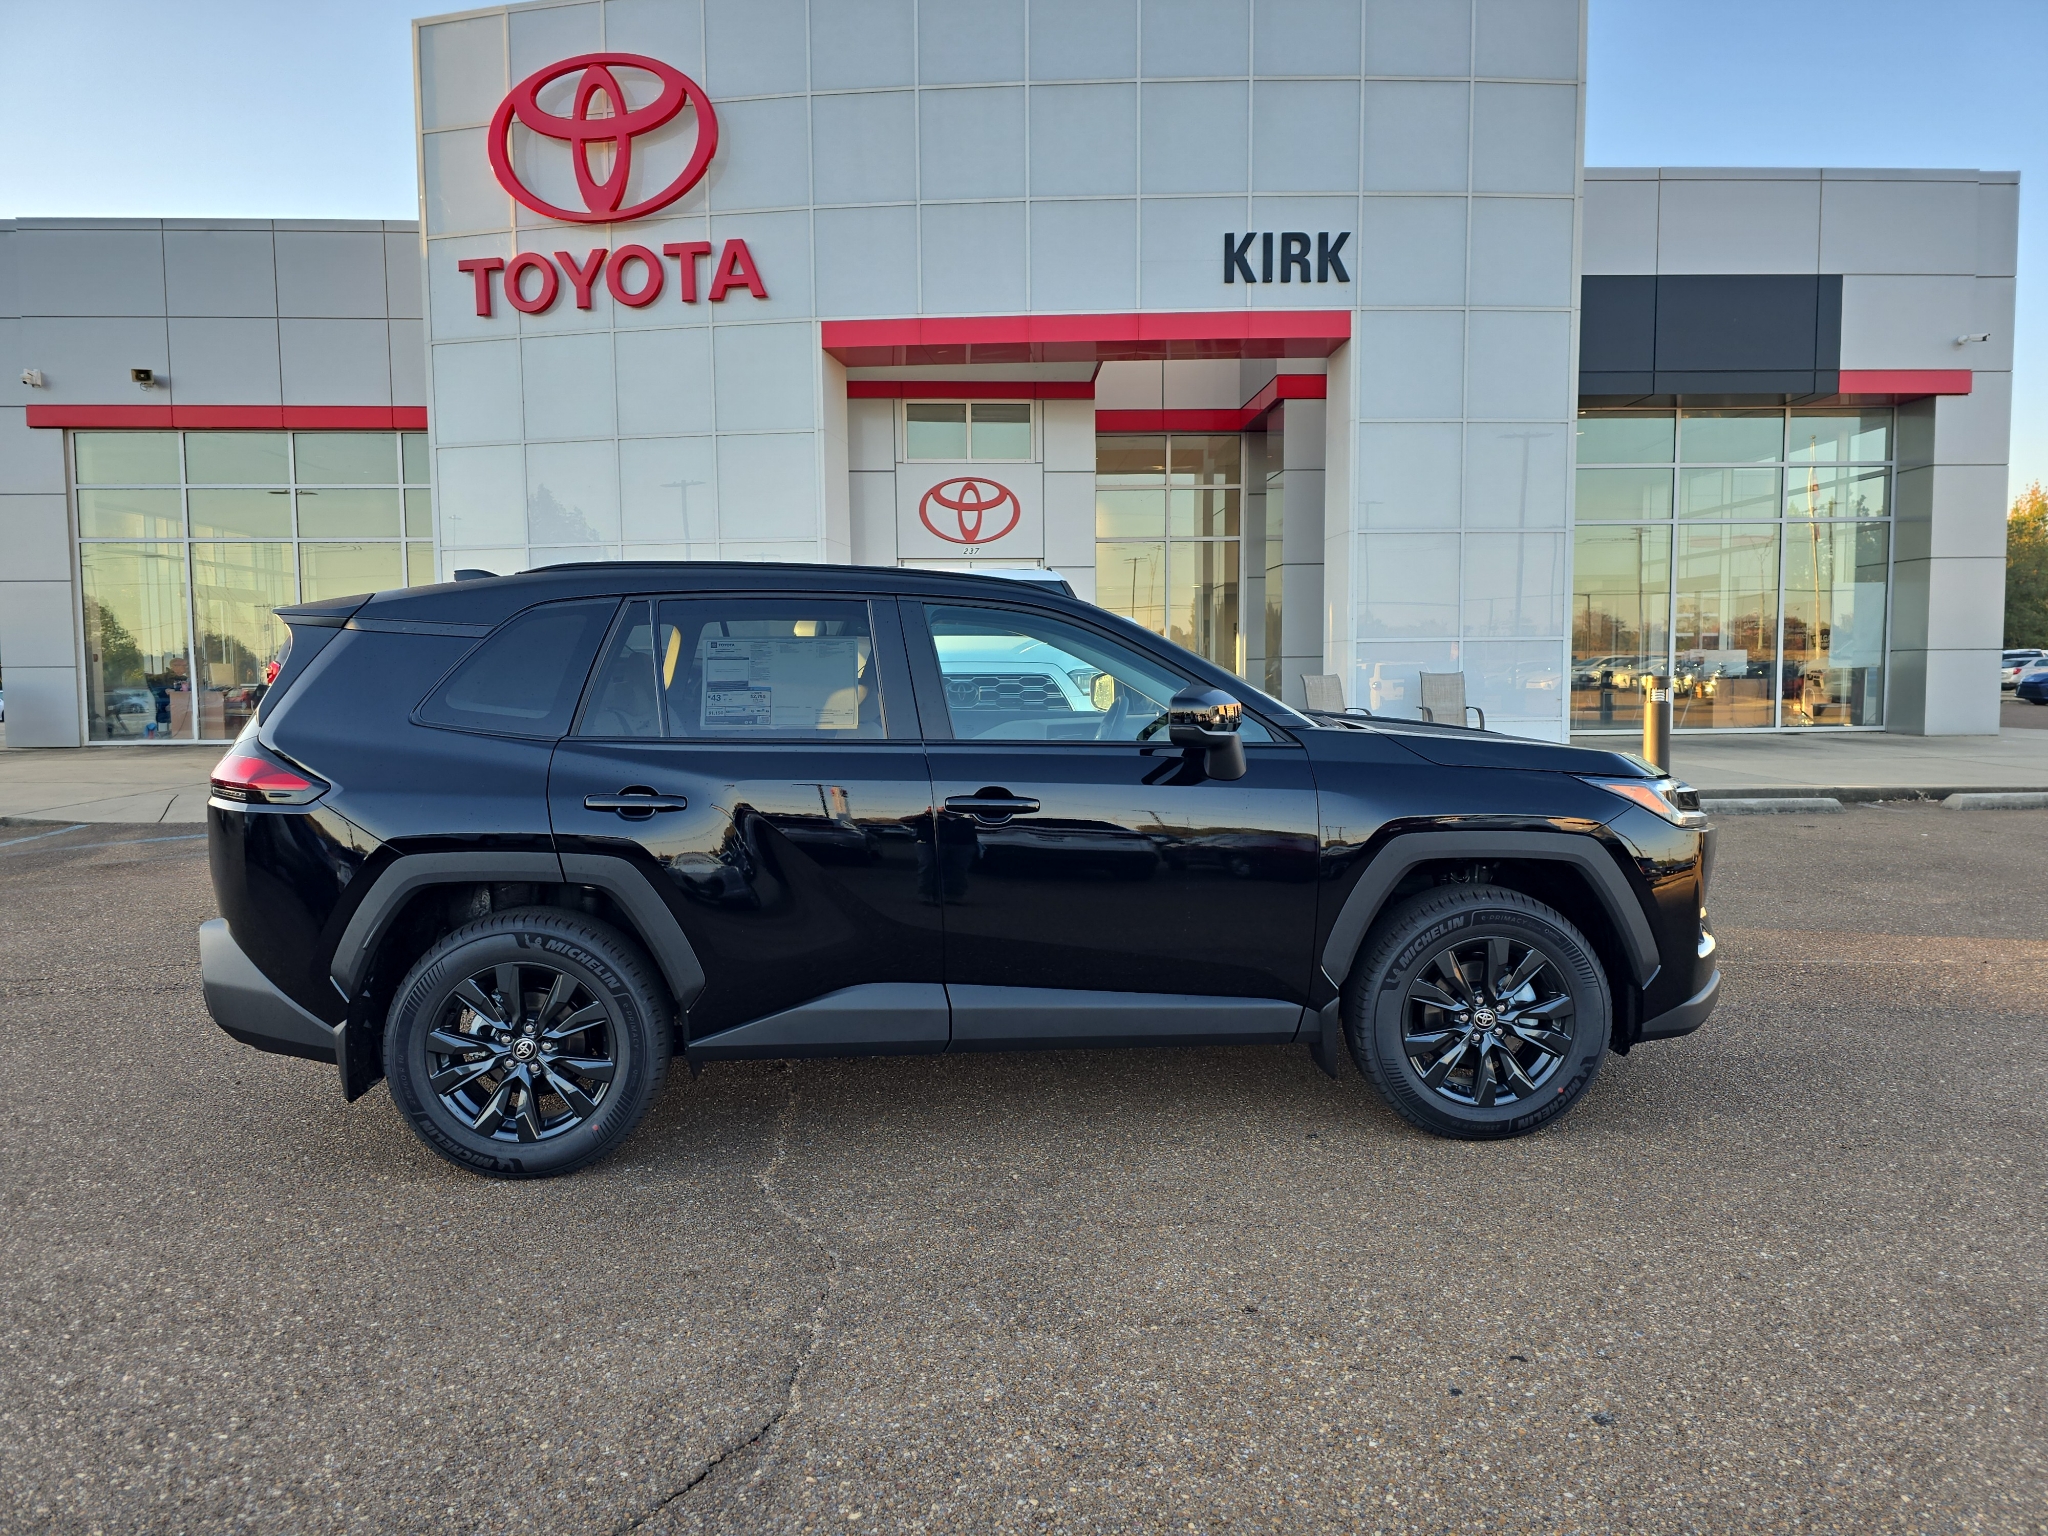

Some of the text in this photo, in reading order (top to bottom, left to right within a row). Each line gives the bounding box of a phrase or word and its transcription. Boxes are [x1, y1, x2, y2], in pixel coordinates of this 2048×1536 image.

[457, 237, 770, 318] TOYOTA
[1224, 231, 1352, 284] KIRK
[963, 547, 980, 555] 237
[545, 938, 620, 990] MICHELIN
[1399, 915, 1466, 967] MICHELIN
[1517, 1076, 1583, 1130] MICHELIN
[420, 1119, 496, 1172] MICHELIN
